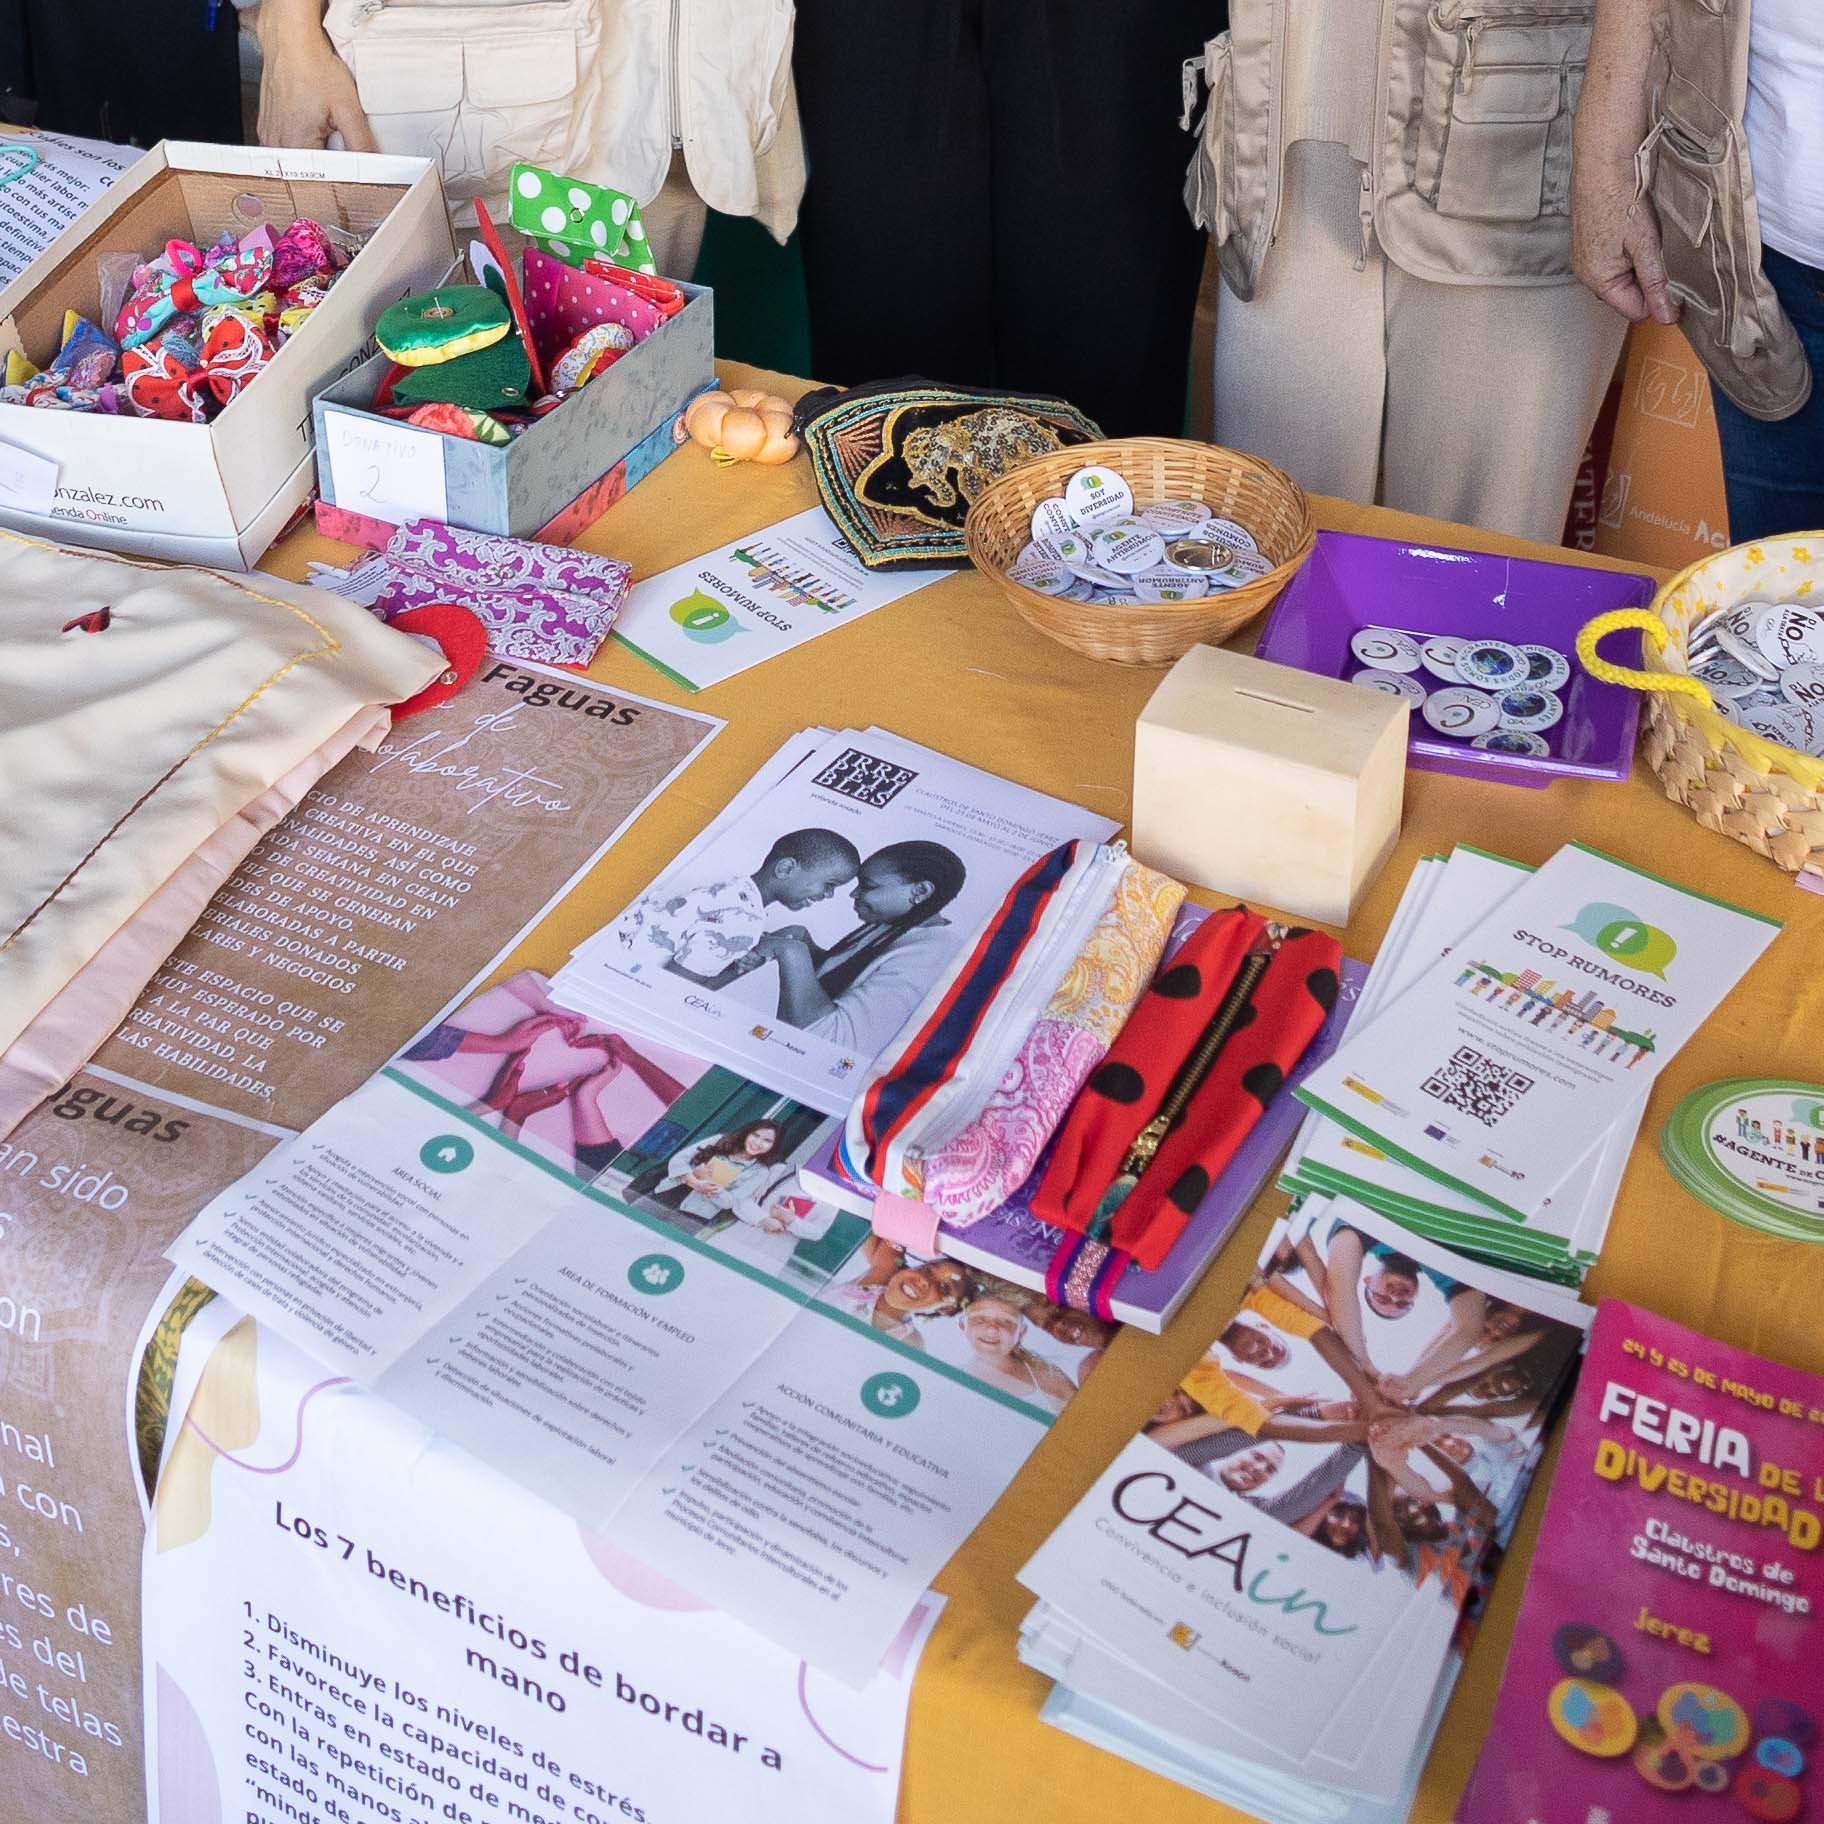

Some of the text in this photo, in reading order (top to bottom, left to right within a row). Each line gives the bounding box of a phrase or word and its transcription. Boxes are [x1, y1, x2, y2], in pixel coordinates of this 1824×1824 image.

[51, 177, 81, 202] labor
[104, 158, 127, 172] los
[360, 465, 387, 504] 2
[1080, 491, 1125, 515] DIVERSIDAD
[1090, 489, 1106, 500] SOY
[86, 510, 128, 525] Online
[697, 570, 792, 632] STOP RUMORES
[481, 663, 641, 726] Faguas
[816, 771, 891, 807] BLES
[831, 759, 902, 797] PETI
[842, 750, 914, 786] IRRE
[303, 807, 480, 877] CREATIVA EN EL QUE
[293, 860, 406, 910] CREATIVIDAD
[302, 843, 459, 910] SEMANA EN CEAIN
[1512, 928, 1678, 1009] STOP RUMORES
[153, 973, 327, 1049] MUY ESPERADO POR
[1712, 1133, 1797, 1174] #AGENTE
[1799, 1170, 1813, 1178] DE
[39, 1158, 130, 1212] sido
[1693, 1366, 1718, 1393] DE
[1721, 1377, 1775, 1411] MAYO
[1778, 1395, 1804, 1420] DE
[1599, 1380, 1752, 1479] FERIA
[1758, 1459, 1804, 1497] DE
[15, 1484, 84, 1533] con
[1593, 1437, 1824, 1553] DIVERSIDAD
[1111, 1471, 1359, 1639] CEAin
[1629, 1534, 1812, 1615] Santo Domingo
[1644, 1516, 1796, 1586] Claustros de
[1093, 1516, 1186, 1587] Convivencia
[1198, 1584, 1271, 1639] inclusión
[1271, 1632, 1322, 1666] social
[65, 1603, 114, 1645] de
[275, 1501, 783, 1771] Los 7 beneficios de bordar a
[1632, 1606, 1713, 1655] Jerez
[32, 1633, 87, 1683] del
[466, 1647, 567, 1714] mano
[37, 1683, 124, 1747] telas
[243, 1600, 261, 1624] 1.
[267, 1614, 387, 1692] Disminuye
[394, 1681, 429, 1714] los
[436, 1702, 525, 1758] niveles
[532, 1752, 561, 1777] de
[243, 1630, 565, 1811] 2. Favorece la capacidad de
